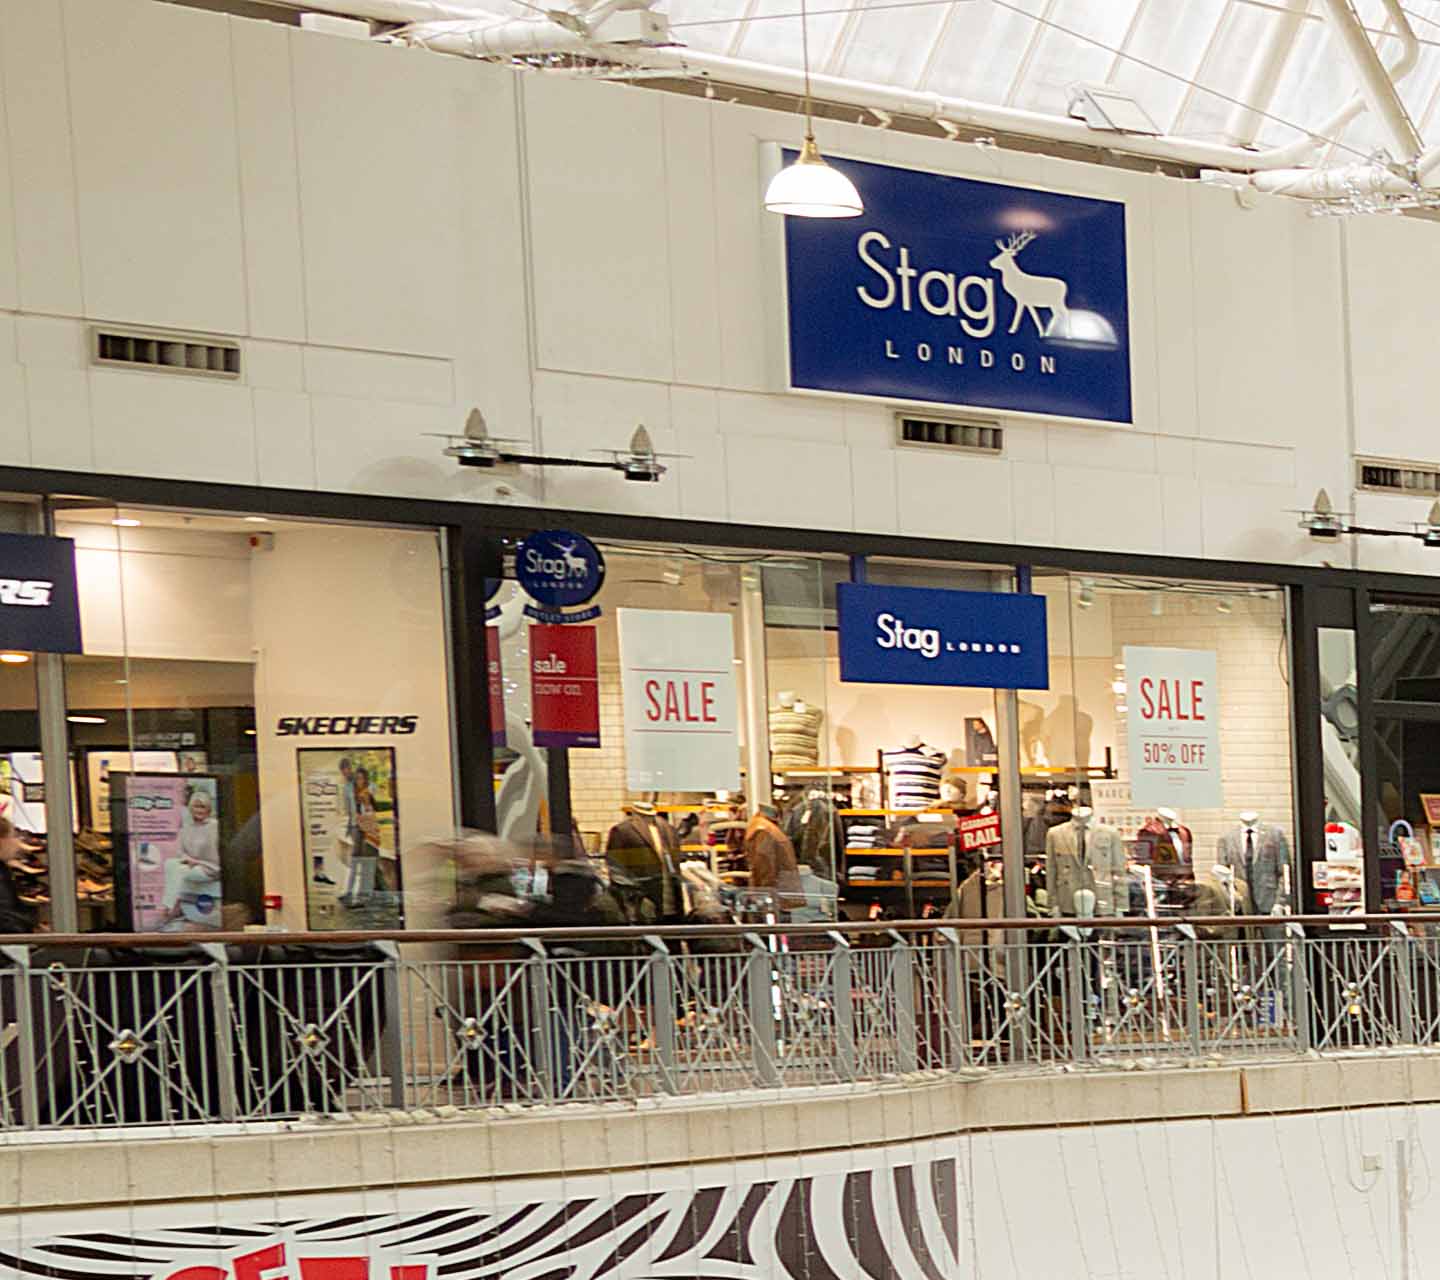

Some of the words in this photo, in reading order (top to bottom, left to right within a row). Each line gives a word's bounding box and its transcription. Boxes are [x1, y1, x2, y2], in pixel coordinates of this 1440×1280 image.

[856, 231, 996, 338] Stag
[885, 339, 1056, 374] LONDON
[526, 548, 565, 580] Stag
[876, 613, 940, 658] Stag
[533, 653, 567, 674] sale
[645, 679, 717, 723] SALE
[1139, 677, 1206, 721] SALE
[276, 715, 418, 737] SKECHERS
[1143, 742, 1176, 764] 50%
[1180, 743, 1206, 764] OFF
[963, 826, 1002, 849] RAIL
